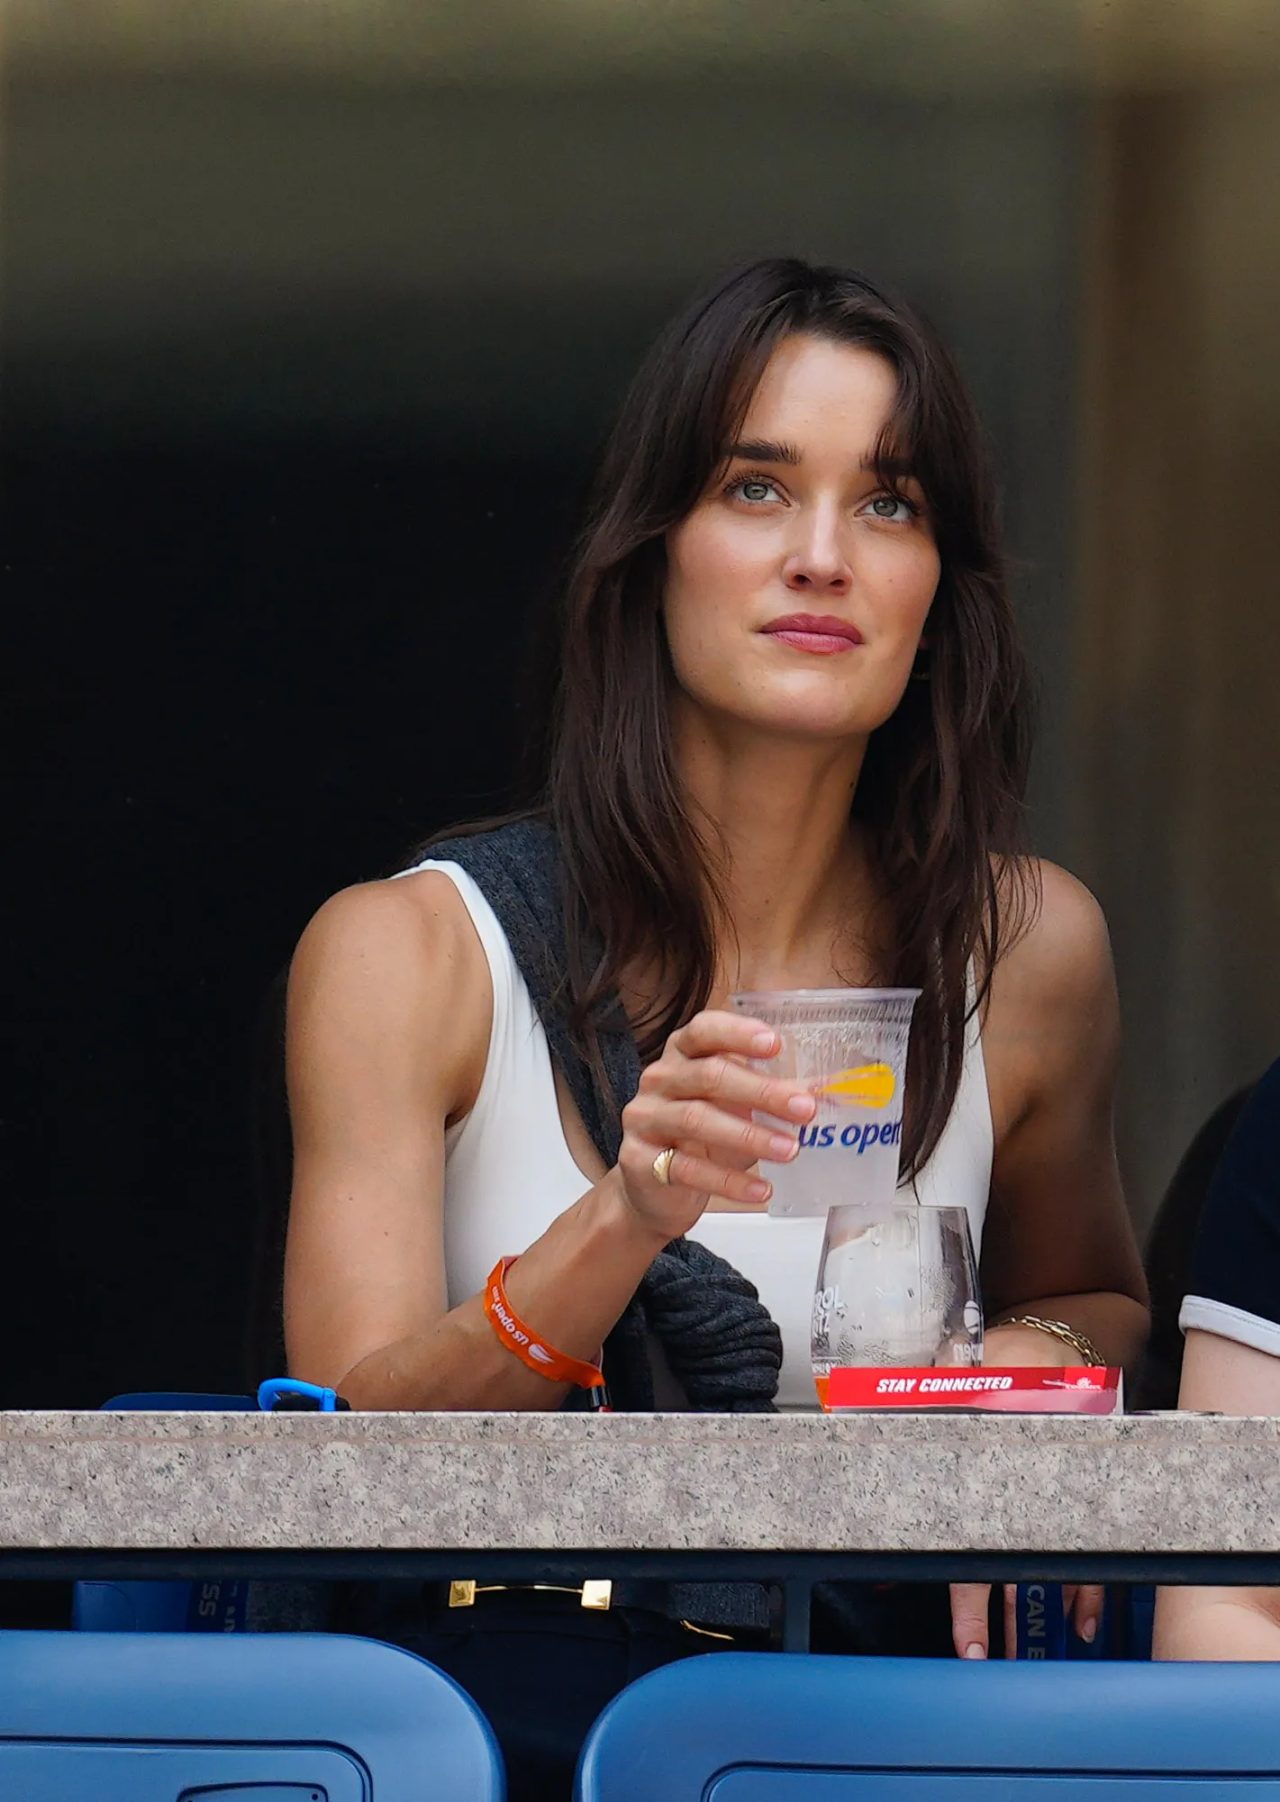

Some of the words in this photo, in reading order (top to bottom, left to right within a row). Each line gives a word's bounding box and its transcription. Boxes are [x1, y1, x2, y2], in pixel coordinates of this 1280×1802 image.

[798, 1123, 837, 1147] us
[840, 1119, 901, 1155] open
[876, 1378, 917, 1394] STAY
[918, 1375, 1014, 1393] CONNECTED
